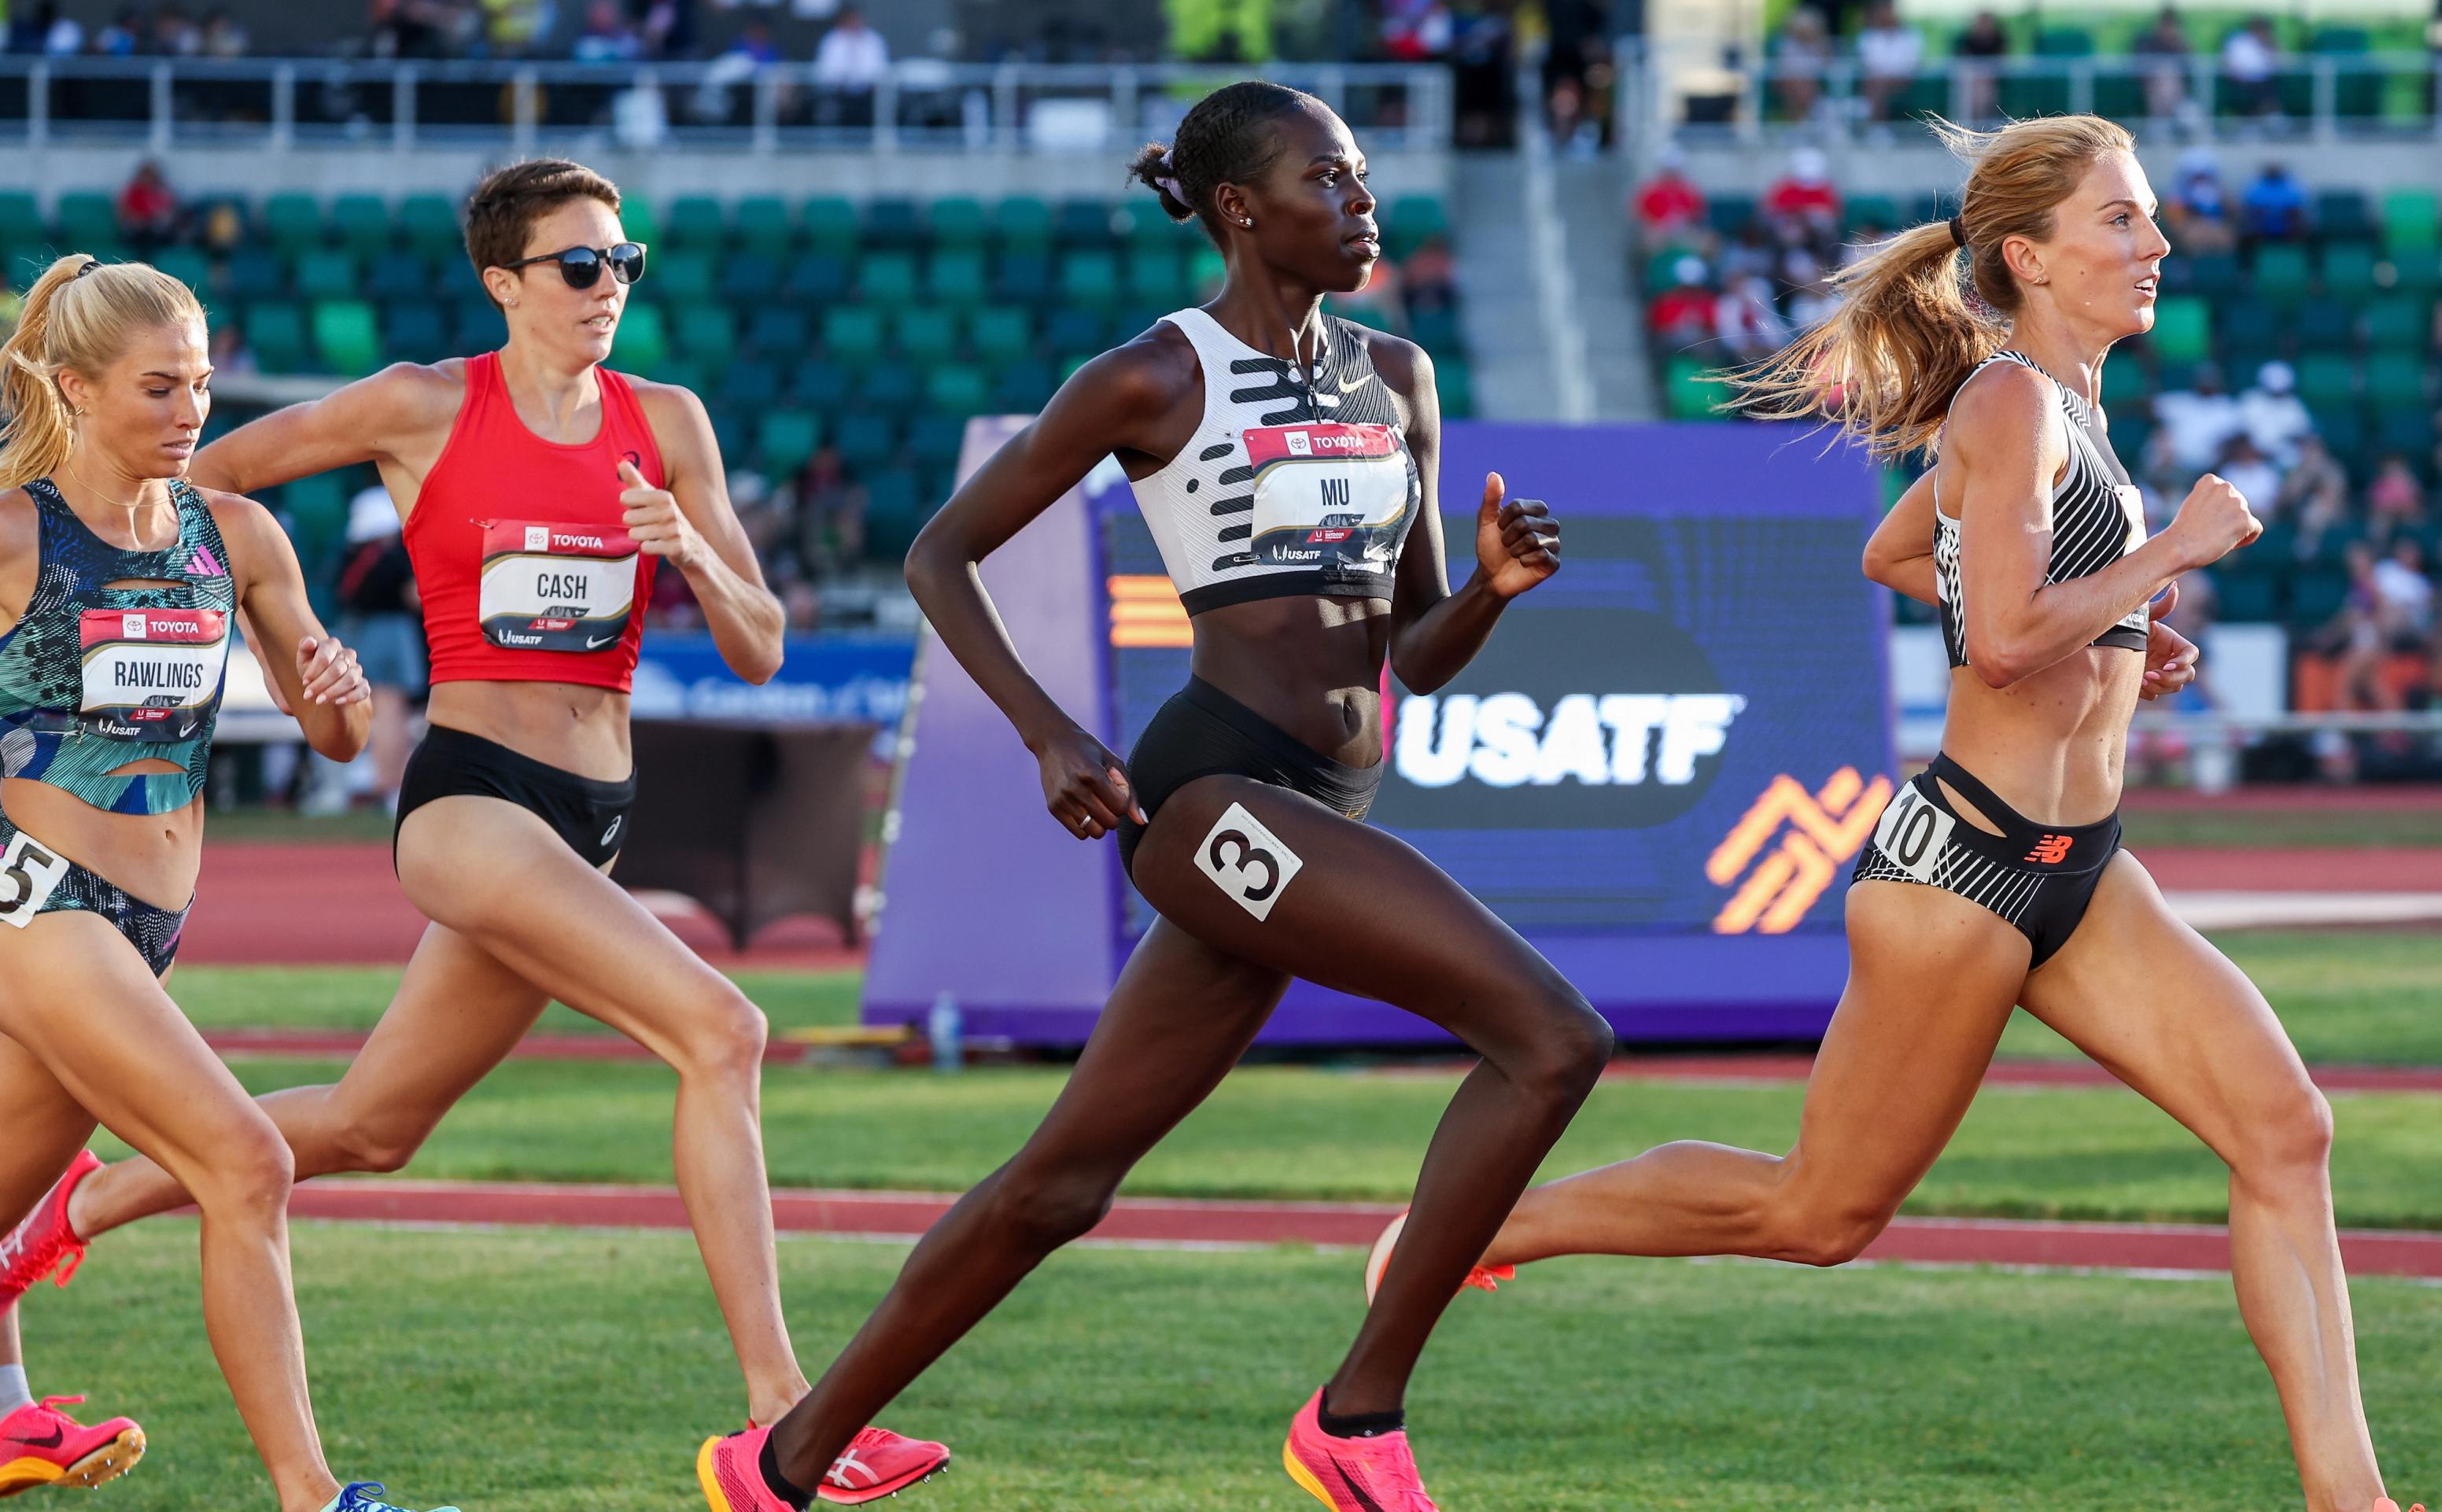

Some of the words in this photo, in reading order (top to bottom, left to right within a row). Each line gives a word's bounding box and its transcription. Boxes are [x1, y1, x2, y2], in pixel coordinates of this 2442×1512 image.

[1313, 436, 1364, 448] TOYOTA
[1320, 478, 1350, 506] MU
[552, 534, 603, 548] TOYOTA
[1287, 550, 1321, 560] USATF
[537, 573, 588, 599] CASH
[149, 621, 199, 633] TOYOTA
[511, 634, 543, 645] USATF
[115, 661, 204, 688] RAWLINGS
[111, 726, 142, 736] USATF
[1394, 692, 1734, 787] USATF
[1885, 792, 1937, 867] 10
[0, 842, 54, 914] 5
[1209, 829, 1280, 902] 3
